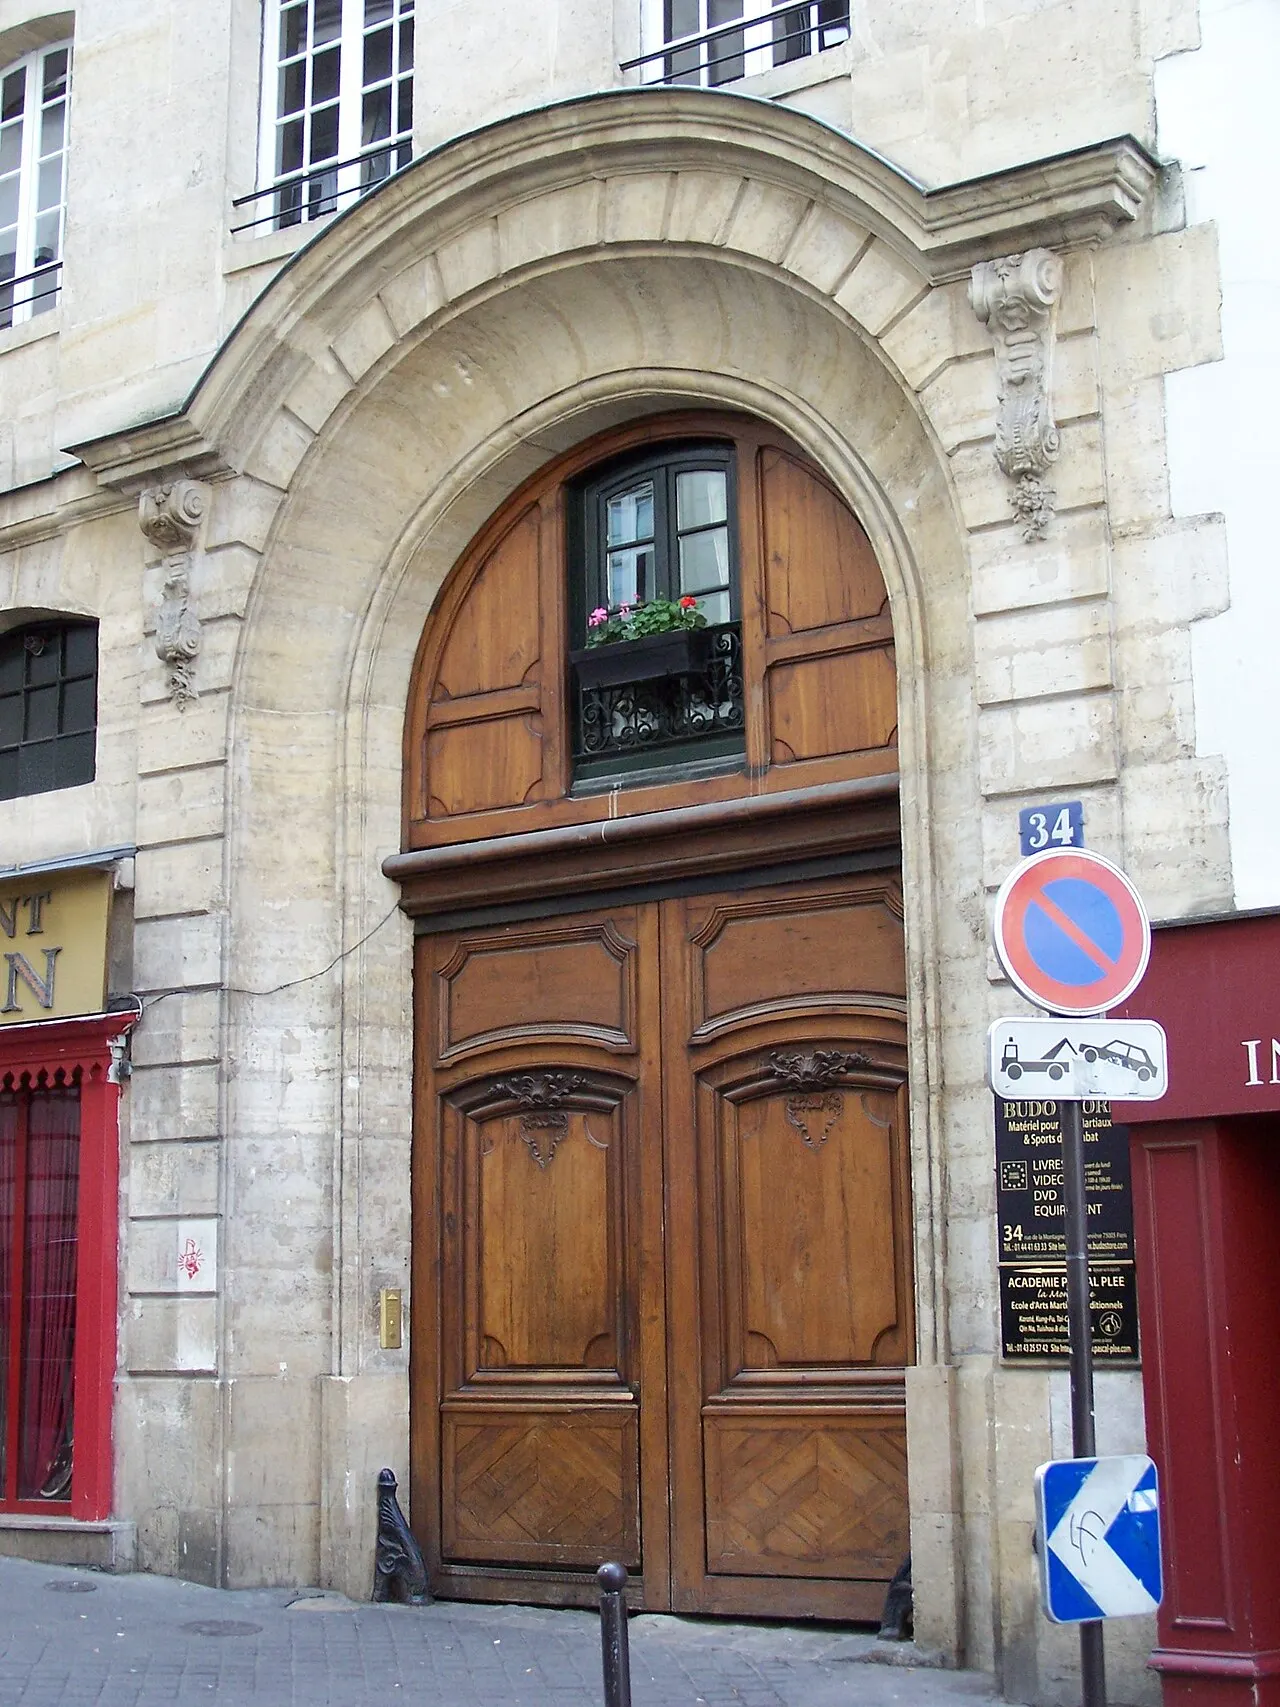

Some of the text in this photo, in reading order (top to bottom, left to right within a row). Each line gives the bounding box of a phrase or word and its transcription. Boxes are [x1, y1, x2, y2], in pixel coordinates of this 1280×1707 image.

[1029, 808, 1074, 848] 34
[1003, 1101, 1056, 1118] BUDO
[1008, 1118, 1112, 1133] Matériel pour artiaux
[1023, 1131, 1098, 1146] & Sports d bat
[1034, 1190, 1057, 1201] DVD
[1003, 1225, 1023, 1241] 34
[1008, 1277, 1059, 1288] ACADEMIE
[1101, 1276, 1125, 1287] PLEE
[1011, 1300, 1123, 1310] Ecole d'Arts Marti ditionnels
